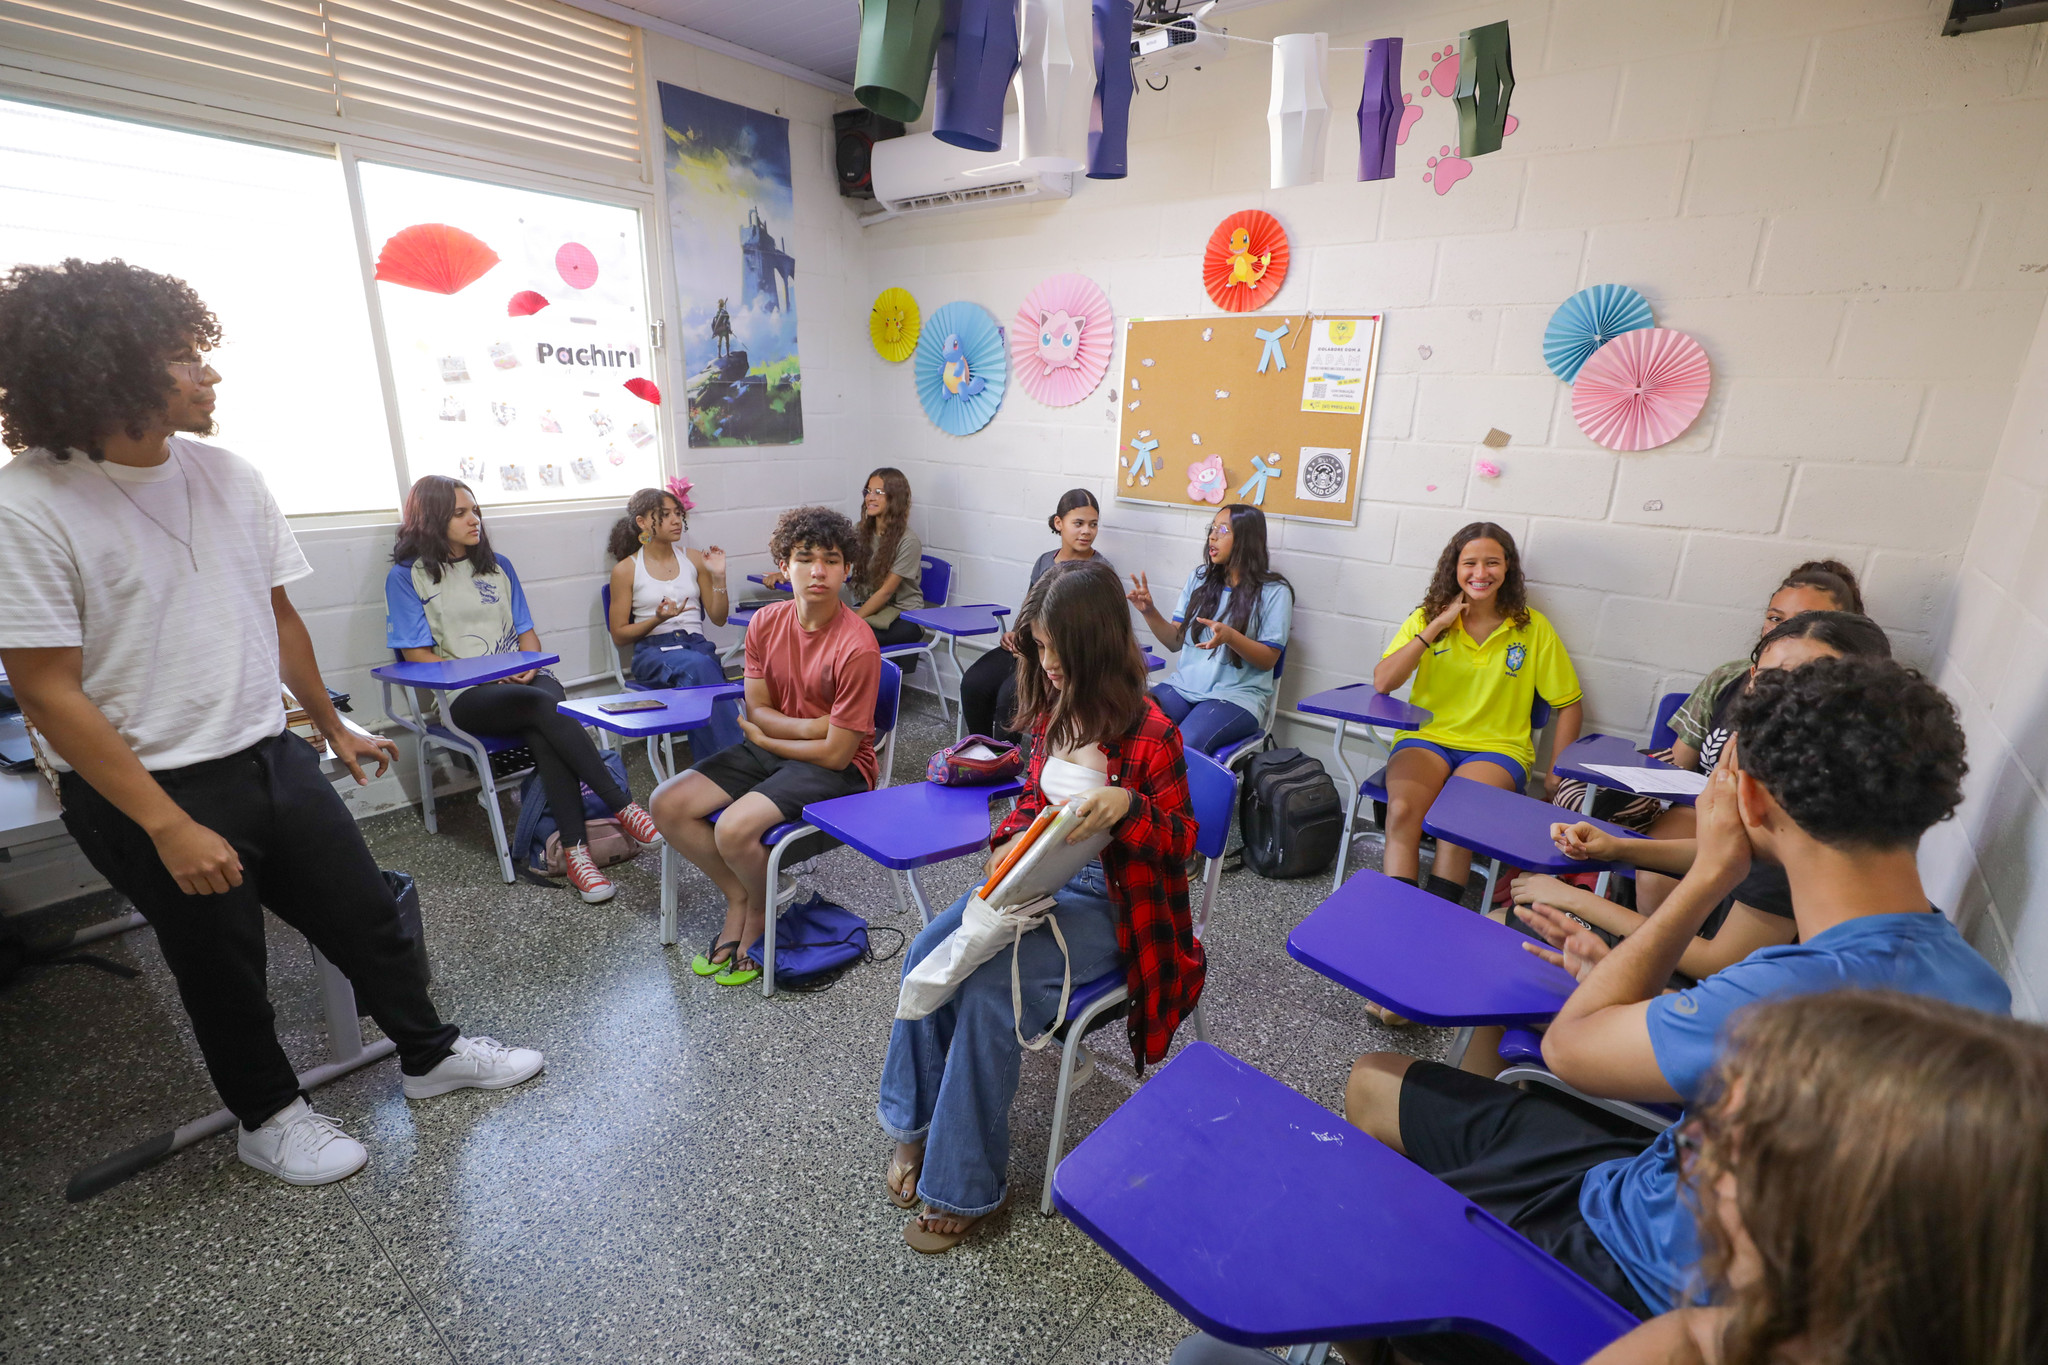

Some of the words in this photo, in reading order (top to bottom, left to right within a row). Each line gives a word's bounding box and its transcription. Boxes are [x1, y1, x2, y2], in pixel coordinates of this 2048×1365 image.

[537, 342, 635, 368] Pachiri
[1312, 353, 1361, 366] APAM
[1308, 482, 1324, 494] MAID
